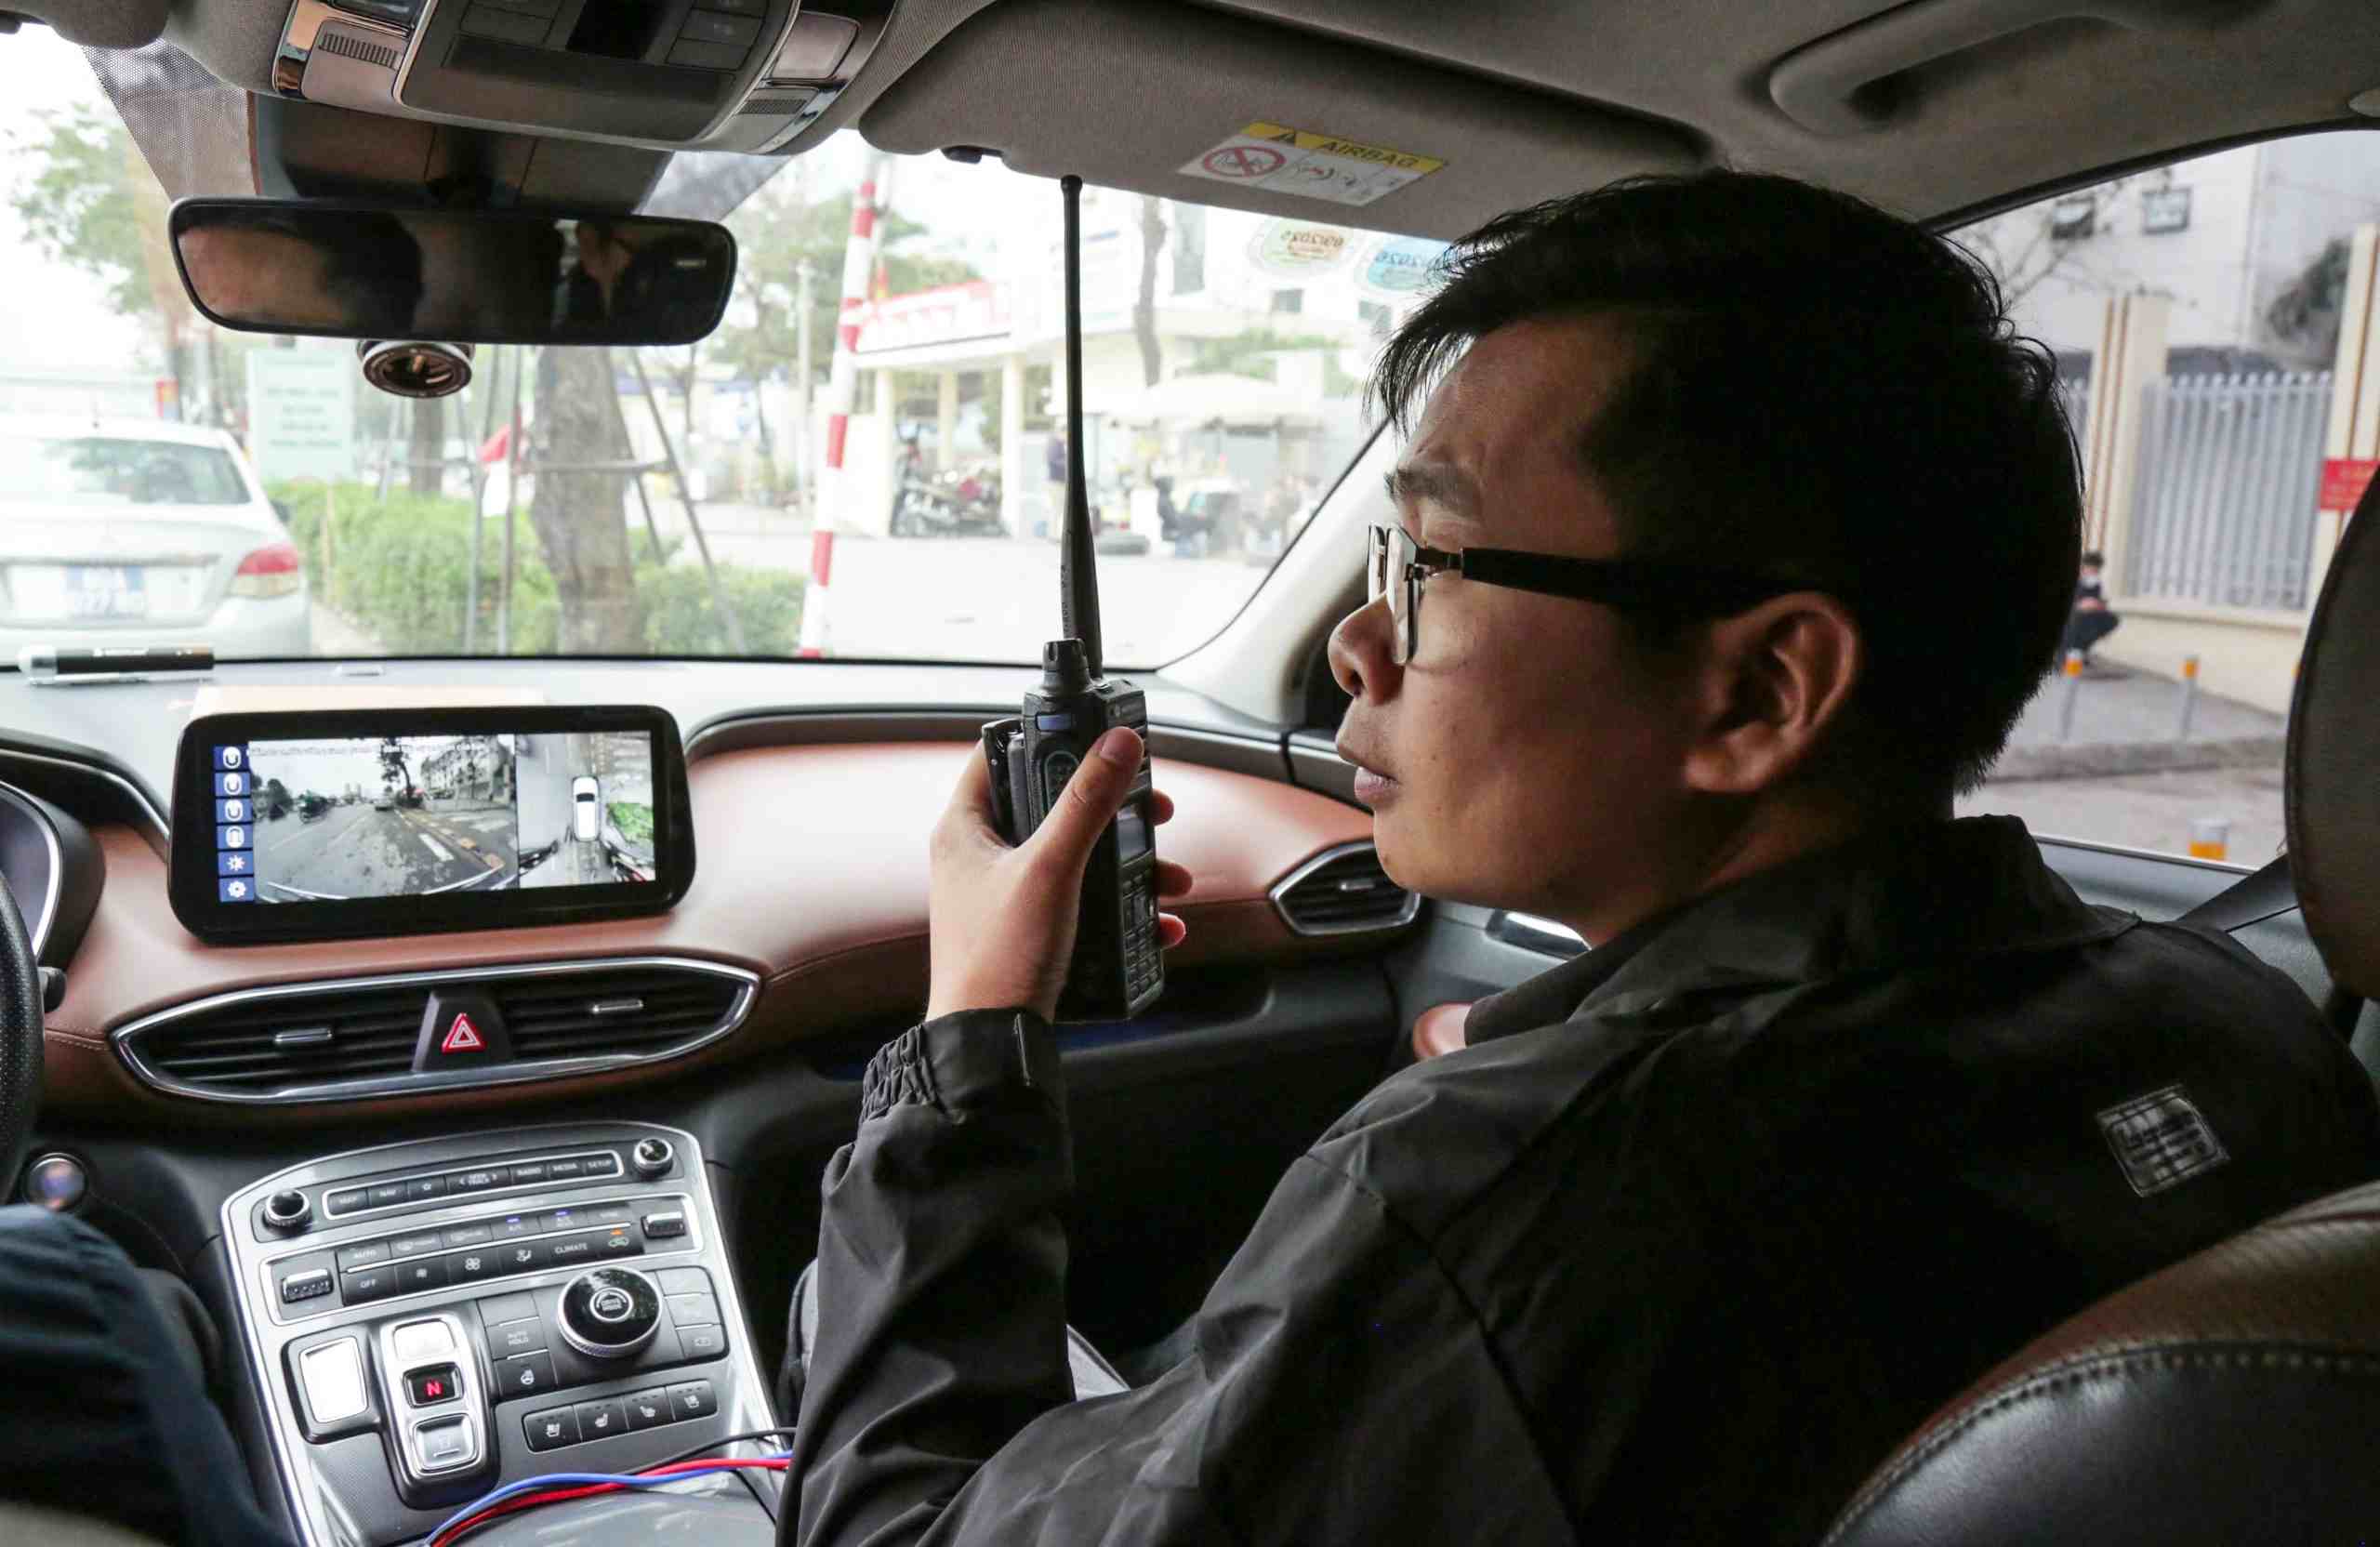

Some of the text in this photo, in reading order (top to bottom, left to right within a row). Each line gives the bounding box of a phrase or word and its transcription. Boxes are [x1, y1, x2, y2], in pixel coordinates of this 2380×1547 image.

[1320, 140, 1420, 167] AIRBAG
[588, 1160, 613, 1169] SETUP
[555, 1243, 588, 1253] CLIMATE
[360, 1279, 377, 1289] OFF
[427, 1380, 442, 1396] N
